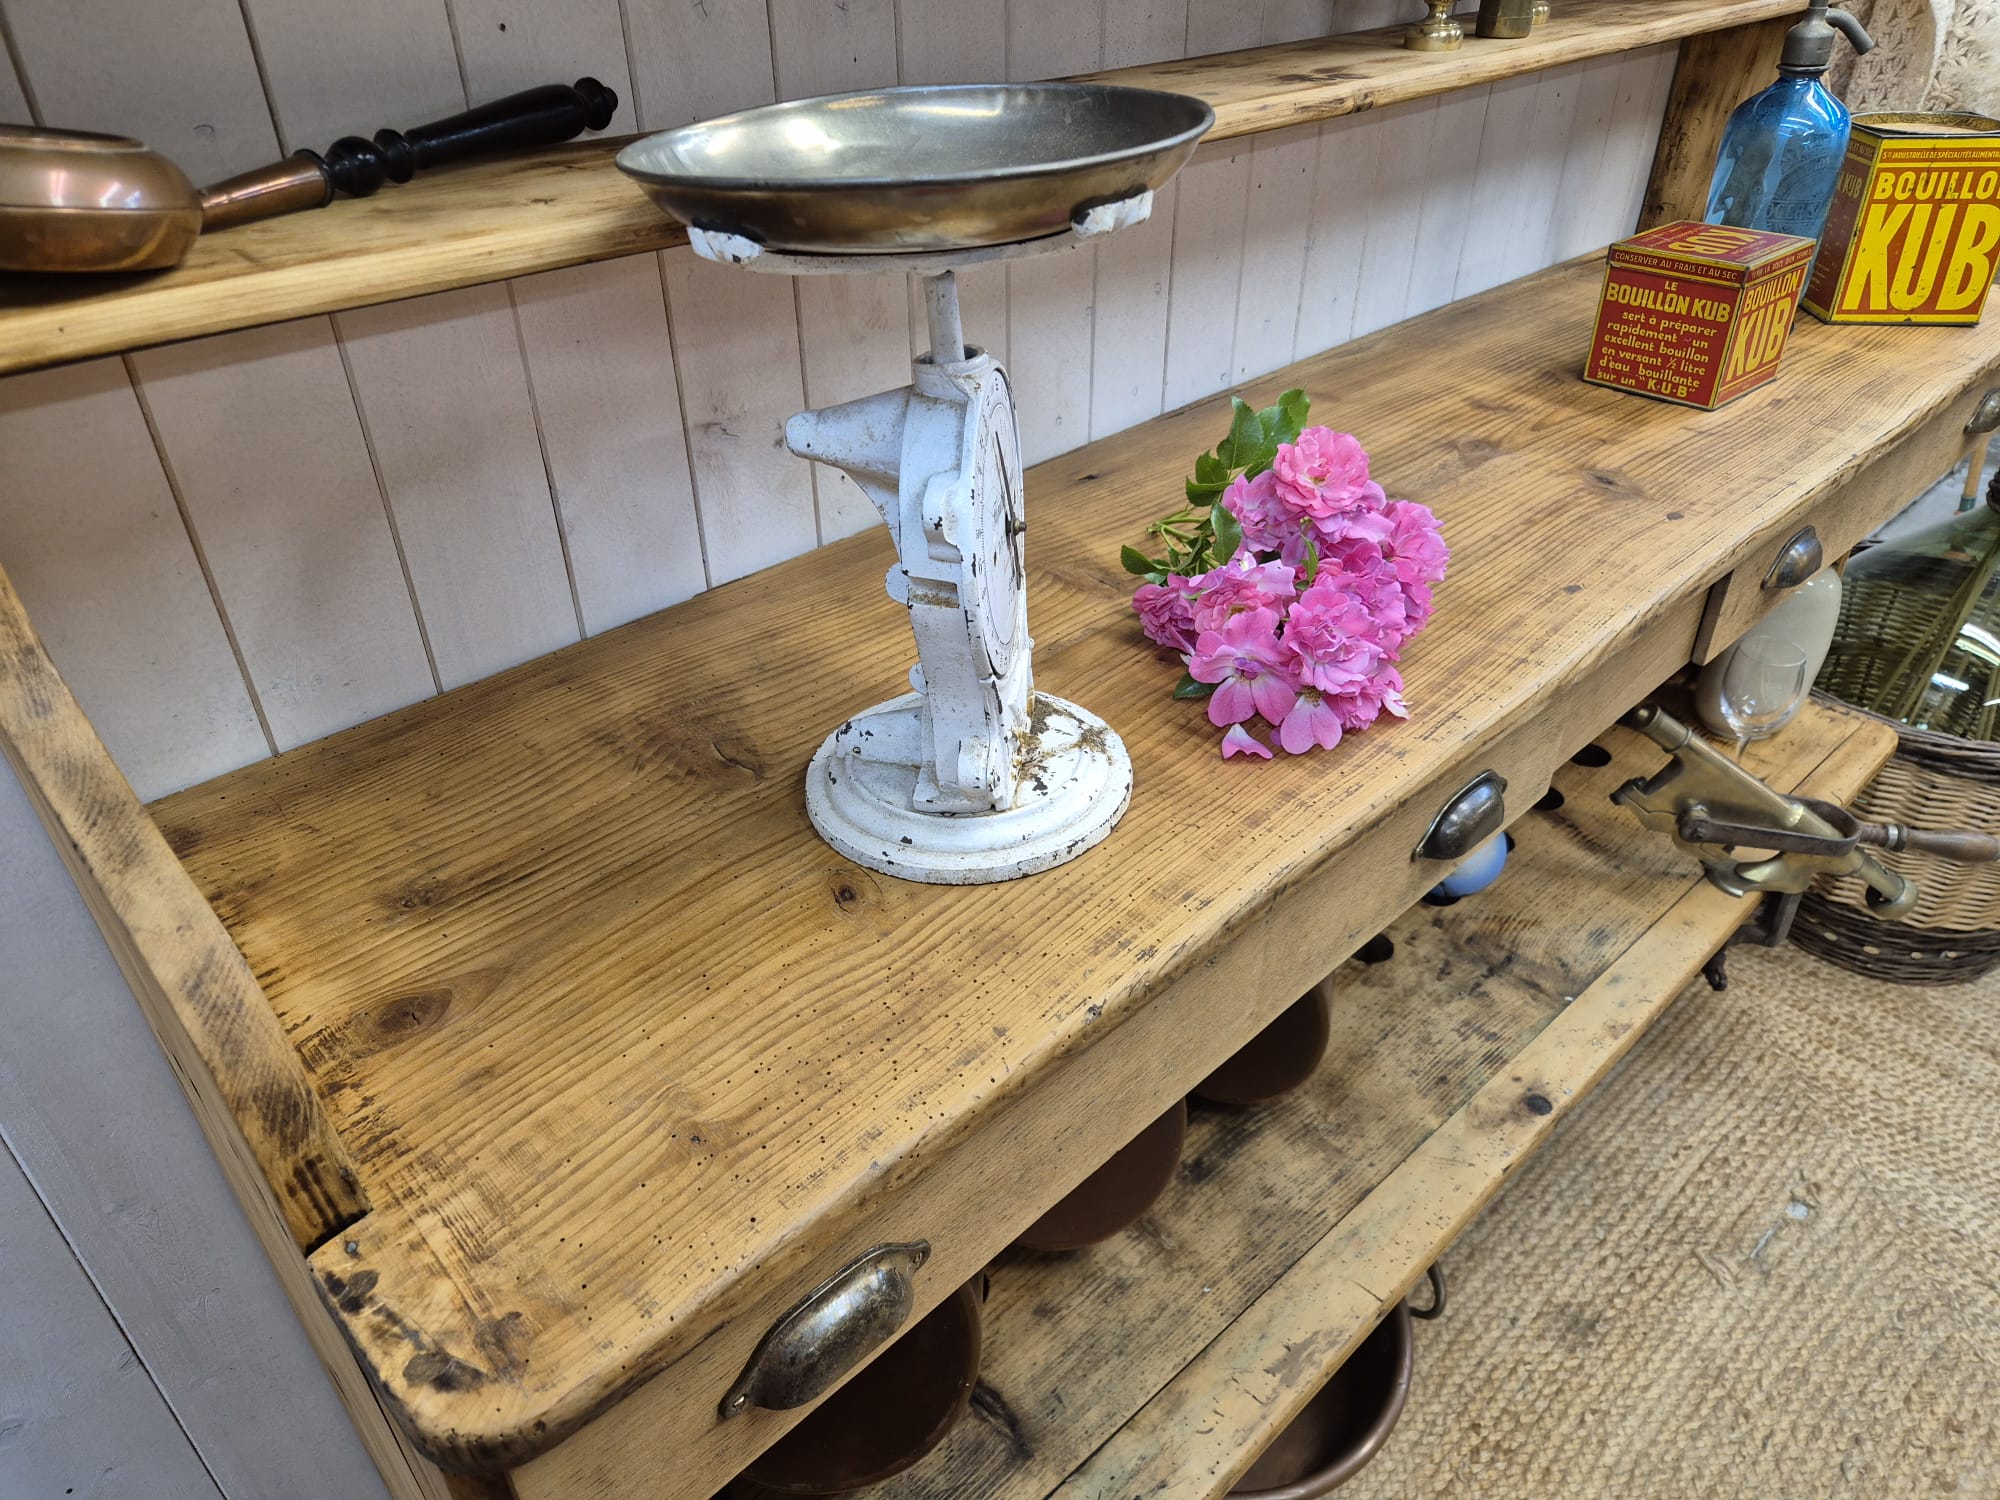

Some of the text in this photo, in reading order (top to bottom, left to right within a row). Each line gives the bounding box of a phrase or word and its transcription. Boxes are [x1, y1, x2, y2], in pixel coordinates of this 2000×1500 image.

[1873, 170, 2000, 201] BOUILLO
[1668, 228, 1762, 255] KUB
[1615, 252, 1737, 280] CONSERVER AU FRAIS ET AU SEC
[1842, 203, 2000, 311] KUB
[1664, 280, 1679, 291] LE
[1743, 269, 1801, 314] BOUILLON
[1606, 282, 1731, 323] BOUILLON KUB
[1607, 321, 1709, 349] rapidement un
[1622, 311, 1646, 323] sert
[1660, 319, 1717, 337] préparer
[1604, 332, 1709, 363] excellent bouillon
[1726, 296, 1792, 382] KUB
[1602, 346, 1615, 356] en
[1619, 349, 1662, 366] versant
[1680, 360, 1706, 376] litre
[1638, 363, 1700, 388] bouillante
[1596, 370, 1616, 381] sur
[1620, 375, 1636, 386] un
